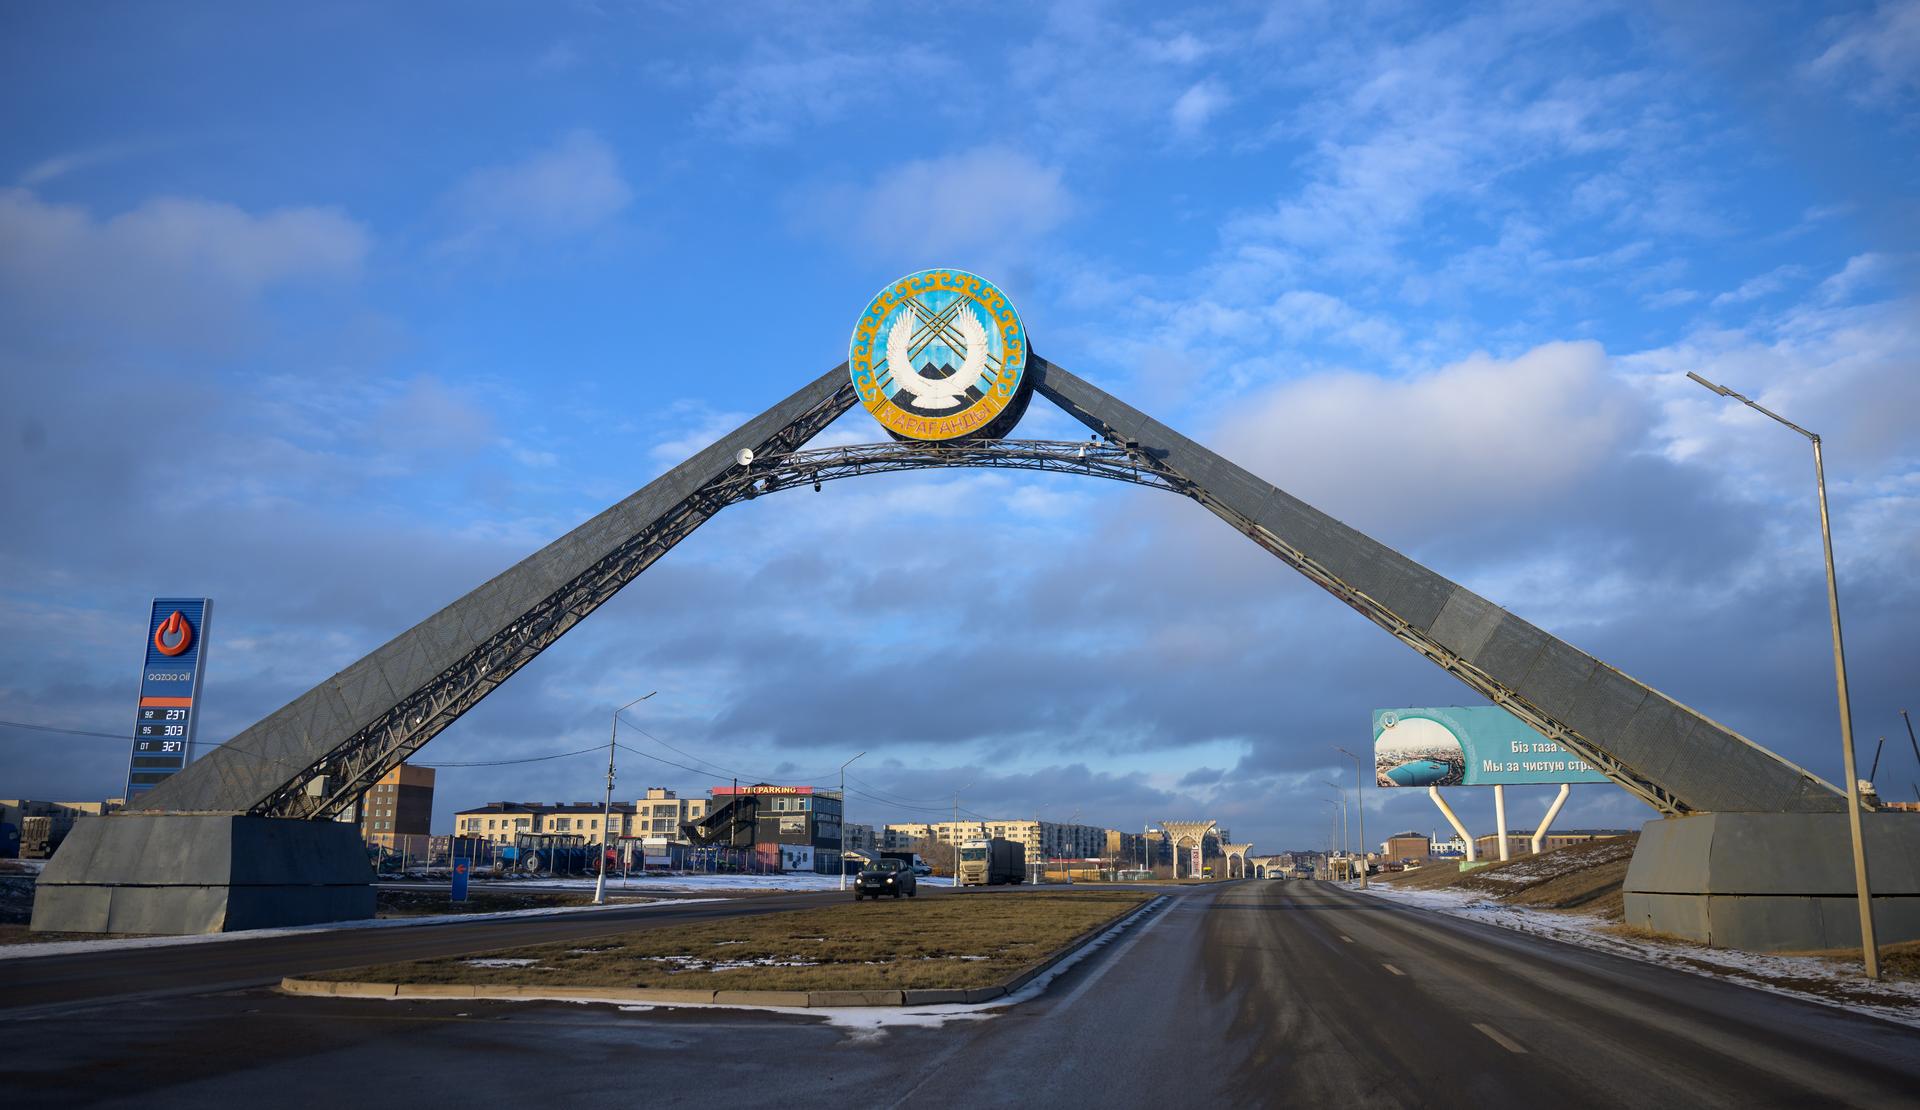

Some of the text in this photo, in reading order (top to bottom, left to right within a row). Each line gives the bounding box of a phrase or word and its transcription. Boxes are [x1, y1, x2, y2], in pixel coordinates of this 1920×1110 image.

[179, 672, 191, 681] oil
[145, 710, 185, 720] 92 237
[143, 725, 183, 736] 95 303
[162, 741, 182, 752] 327
[1511, 741, 1529, 753] Біз
[1532, 743, 1557, 753] таза
[1483, 759, 1503, 772] Мы
[1506, 762, 1520, 772] за
[1522, 761, 1565, 773] чистую
